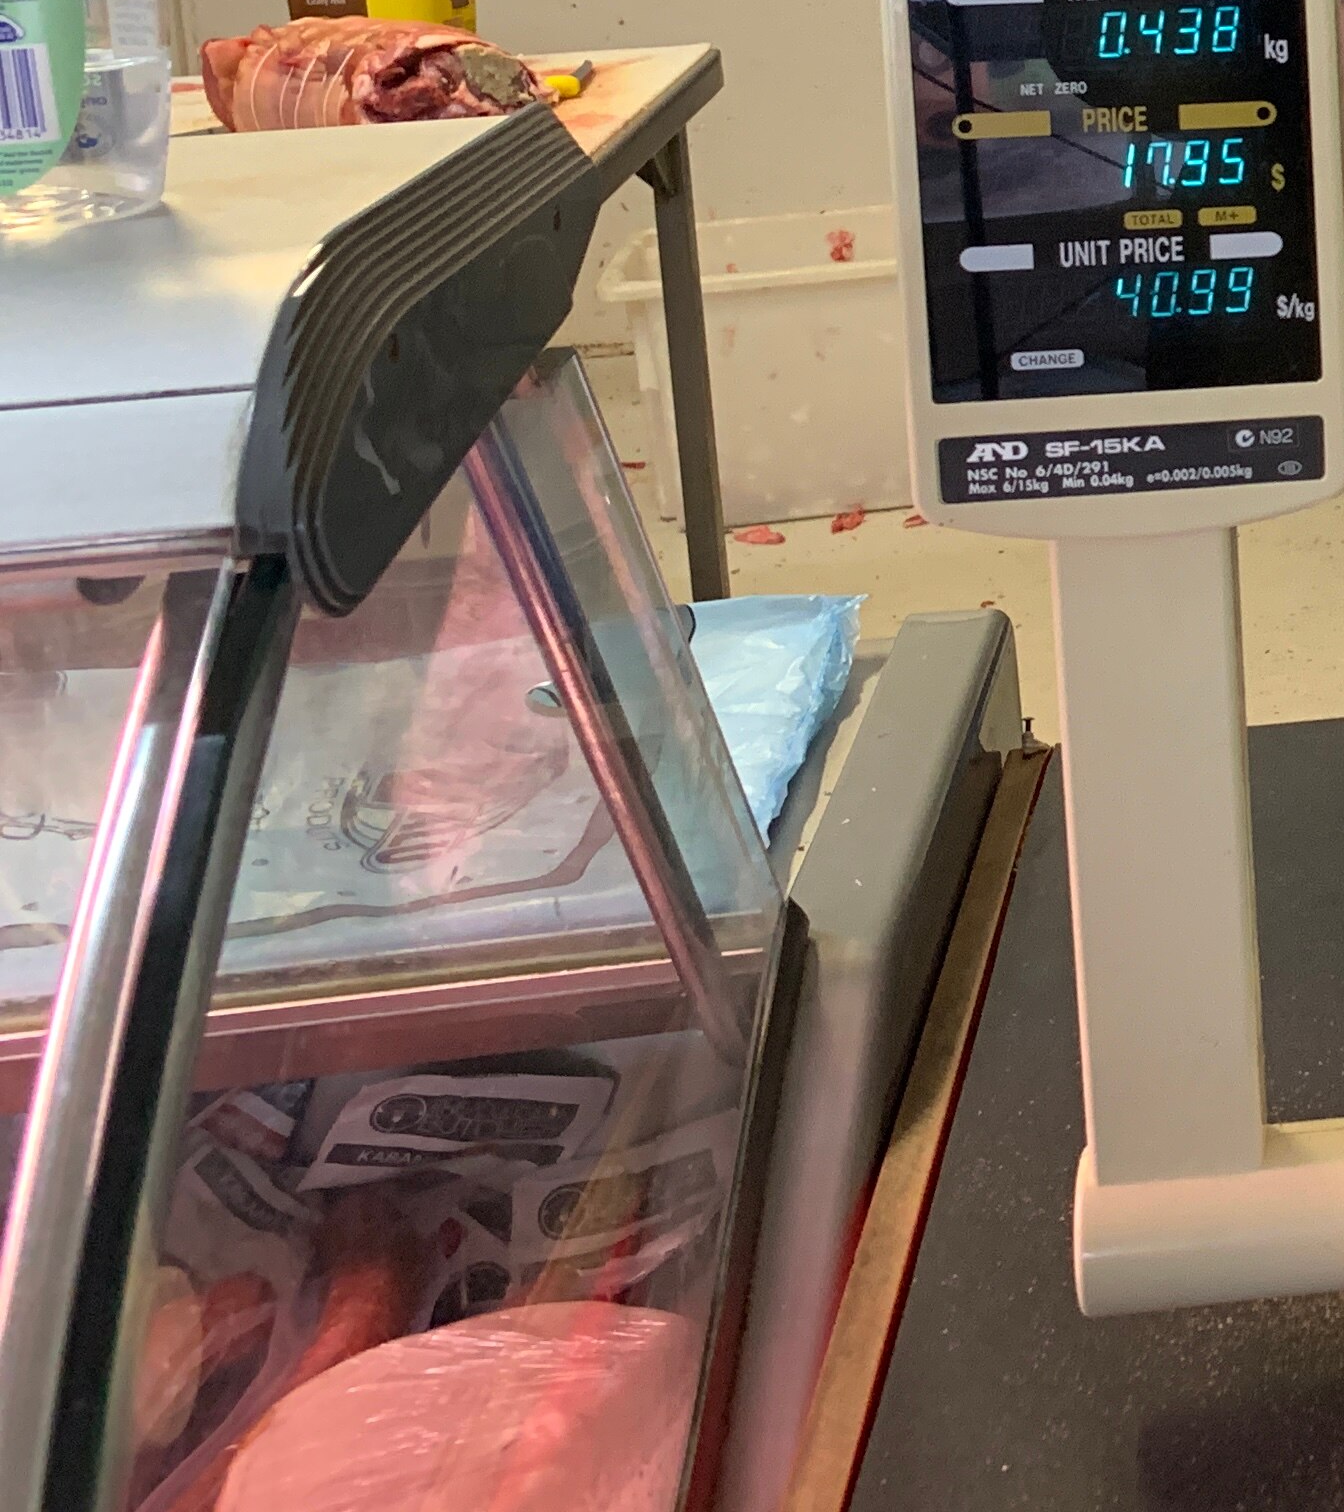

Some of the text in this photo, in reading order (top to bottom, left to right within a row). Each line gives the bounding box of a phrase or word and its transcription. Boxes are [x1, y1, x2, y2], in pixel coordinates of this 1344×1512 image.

[1099, 6, 1239, 58] 0.438
[1264, 34, 1288, 63] kg
[1020, 82, 1088, 96] NET ZERO
[1083, 107, 1148, 132] PRICE
[1123, 137, 1245, 188] 17.95
[1271, 163, 1286, 192] $
[1131, 210, 1240, 225] TOTAL M+
[1060, 237, 1185, 268] UNIT PRICE
[1116, 267, 1254, 317] 40.99
[1276, 293, 1315, 322] $/kg
[1018, 353, 1076, 367] CHANGE
[1045, 435, 1166, 459] SF-15KA
[1259, 428, 1294, 445] N92
[967, 461, 1109, 482] NSC No 6/4D/291
[968, 481, 998, 495] Max
[1003, 479, 1049, 495] 6/15kg
[1062, 474, 1086, 488] Min
[1090, 474, 1134, 490] 0.04kg
